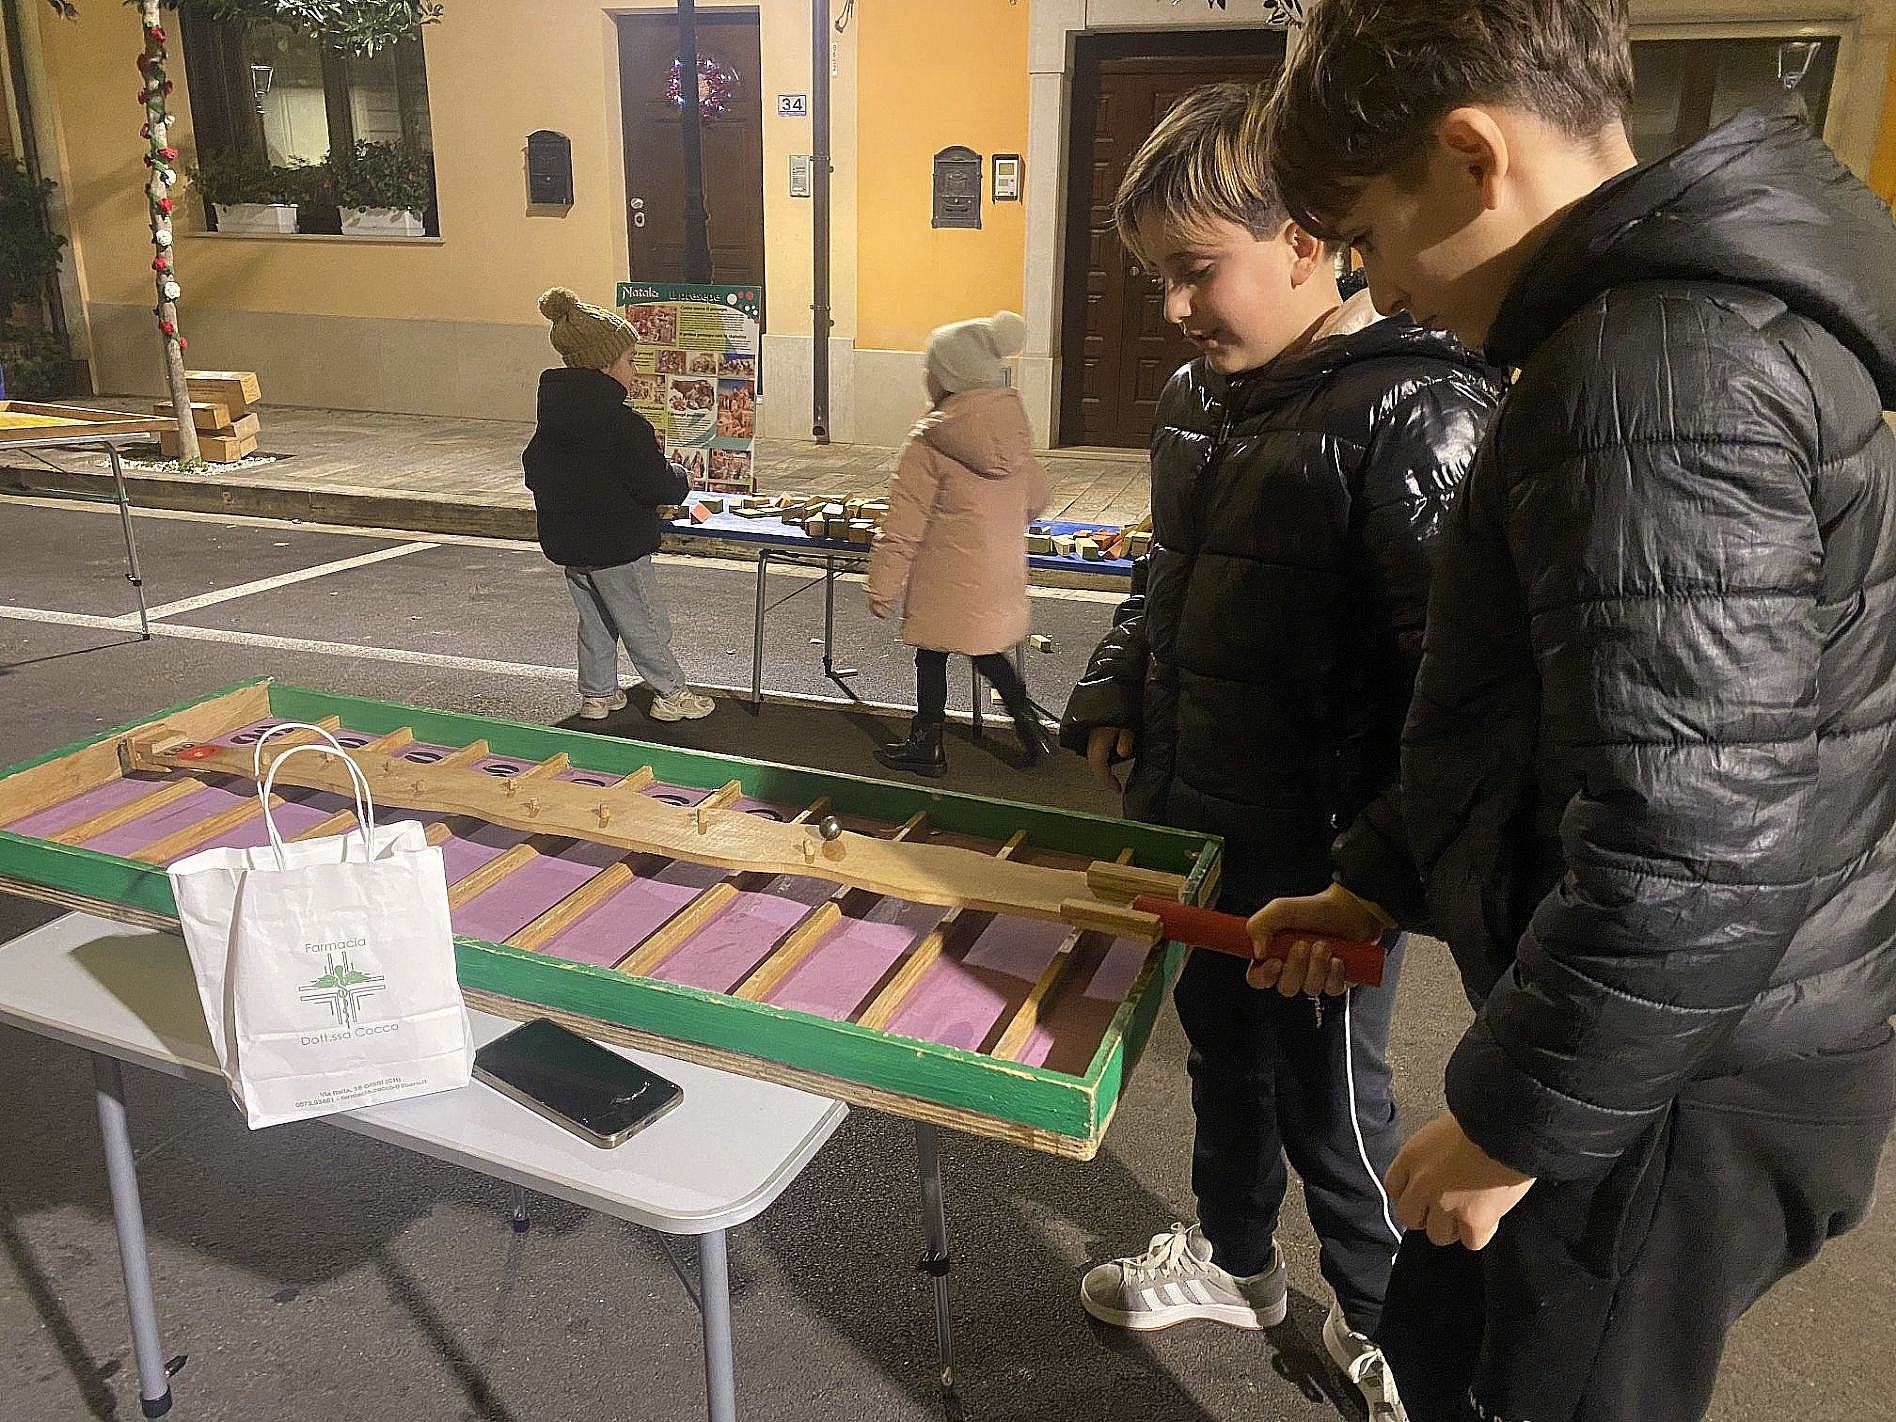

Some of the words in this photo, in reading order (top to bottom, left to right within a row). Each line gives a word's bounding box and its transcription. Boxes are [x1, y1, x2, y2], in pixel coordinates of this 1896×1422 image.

[782, 98, 803, 111] 34
[622, 286, 659, 299] Natale
[305, 937, 366, 953] Farmacia
